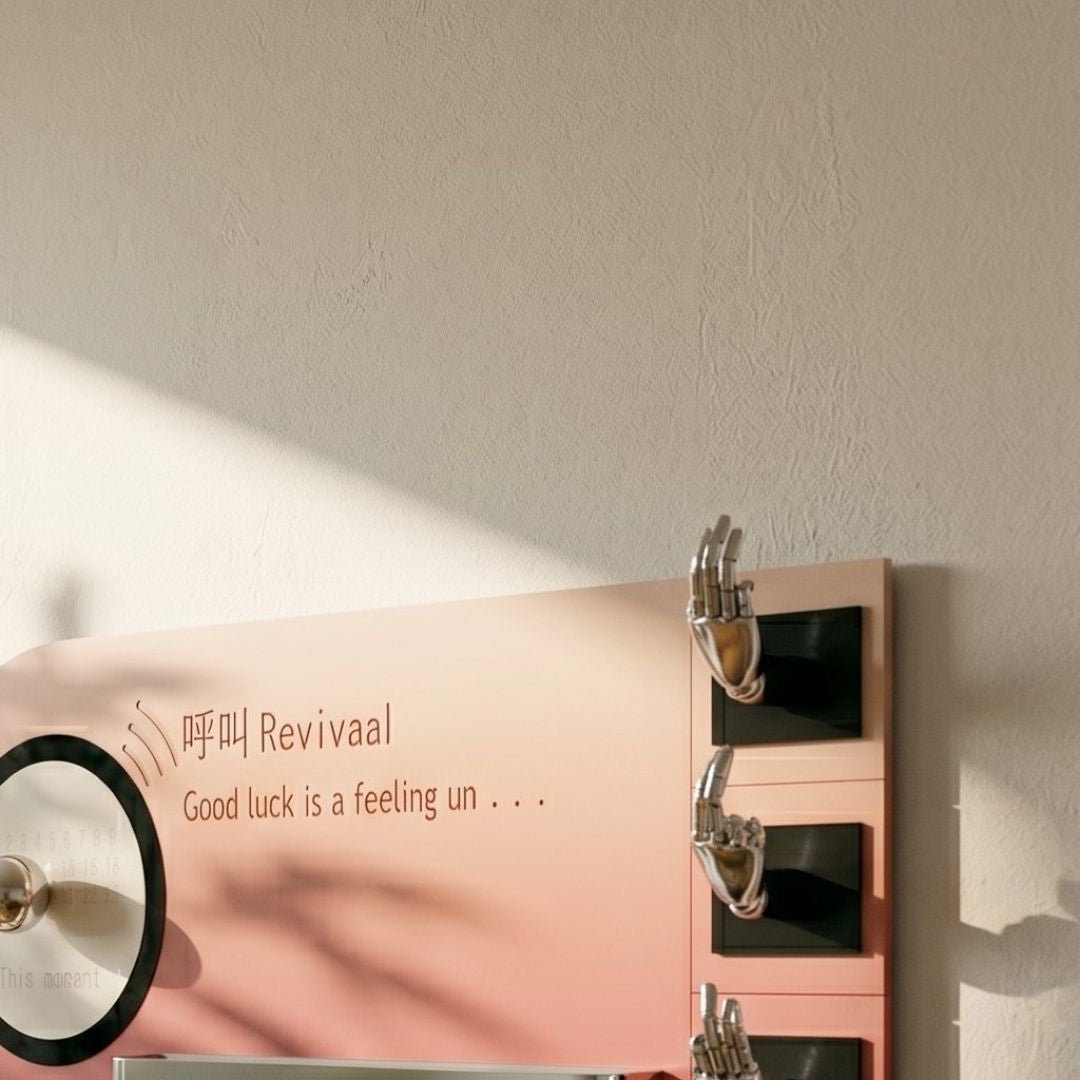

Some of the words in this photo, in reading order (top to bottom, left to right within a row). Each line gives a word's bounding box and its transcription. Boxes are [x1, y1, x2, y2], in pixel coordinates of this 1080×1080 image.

[182, 706, 248, 761] 呼叫
[260, 701, 391, 754] Revivaal
[183, 786, 239, 822] Good
[248, 783, 295, 820] luck
[305, 784, 322, 818] is
[331, 792, 345, 816] a
[353, 778, 438, 822] feeling
[447, 785, 477, 811] un
[0, 966, 33, 989] This
